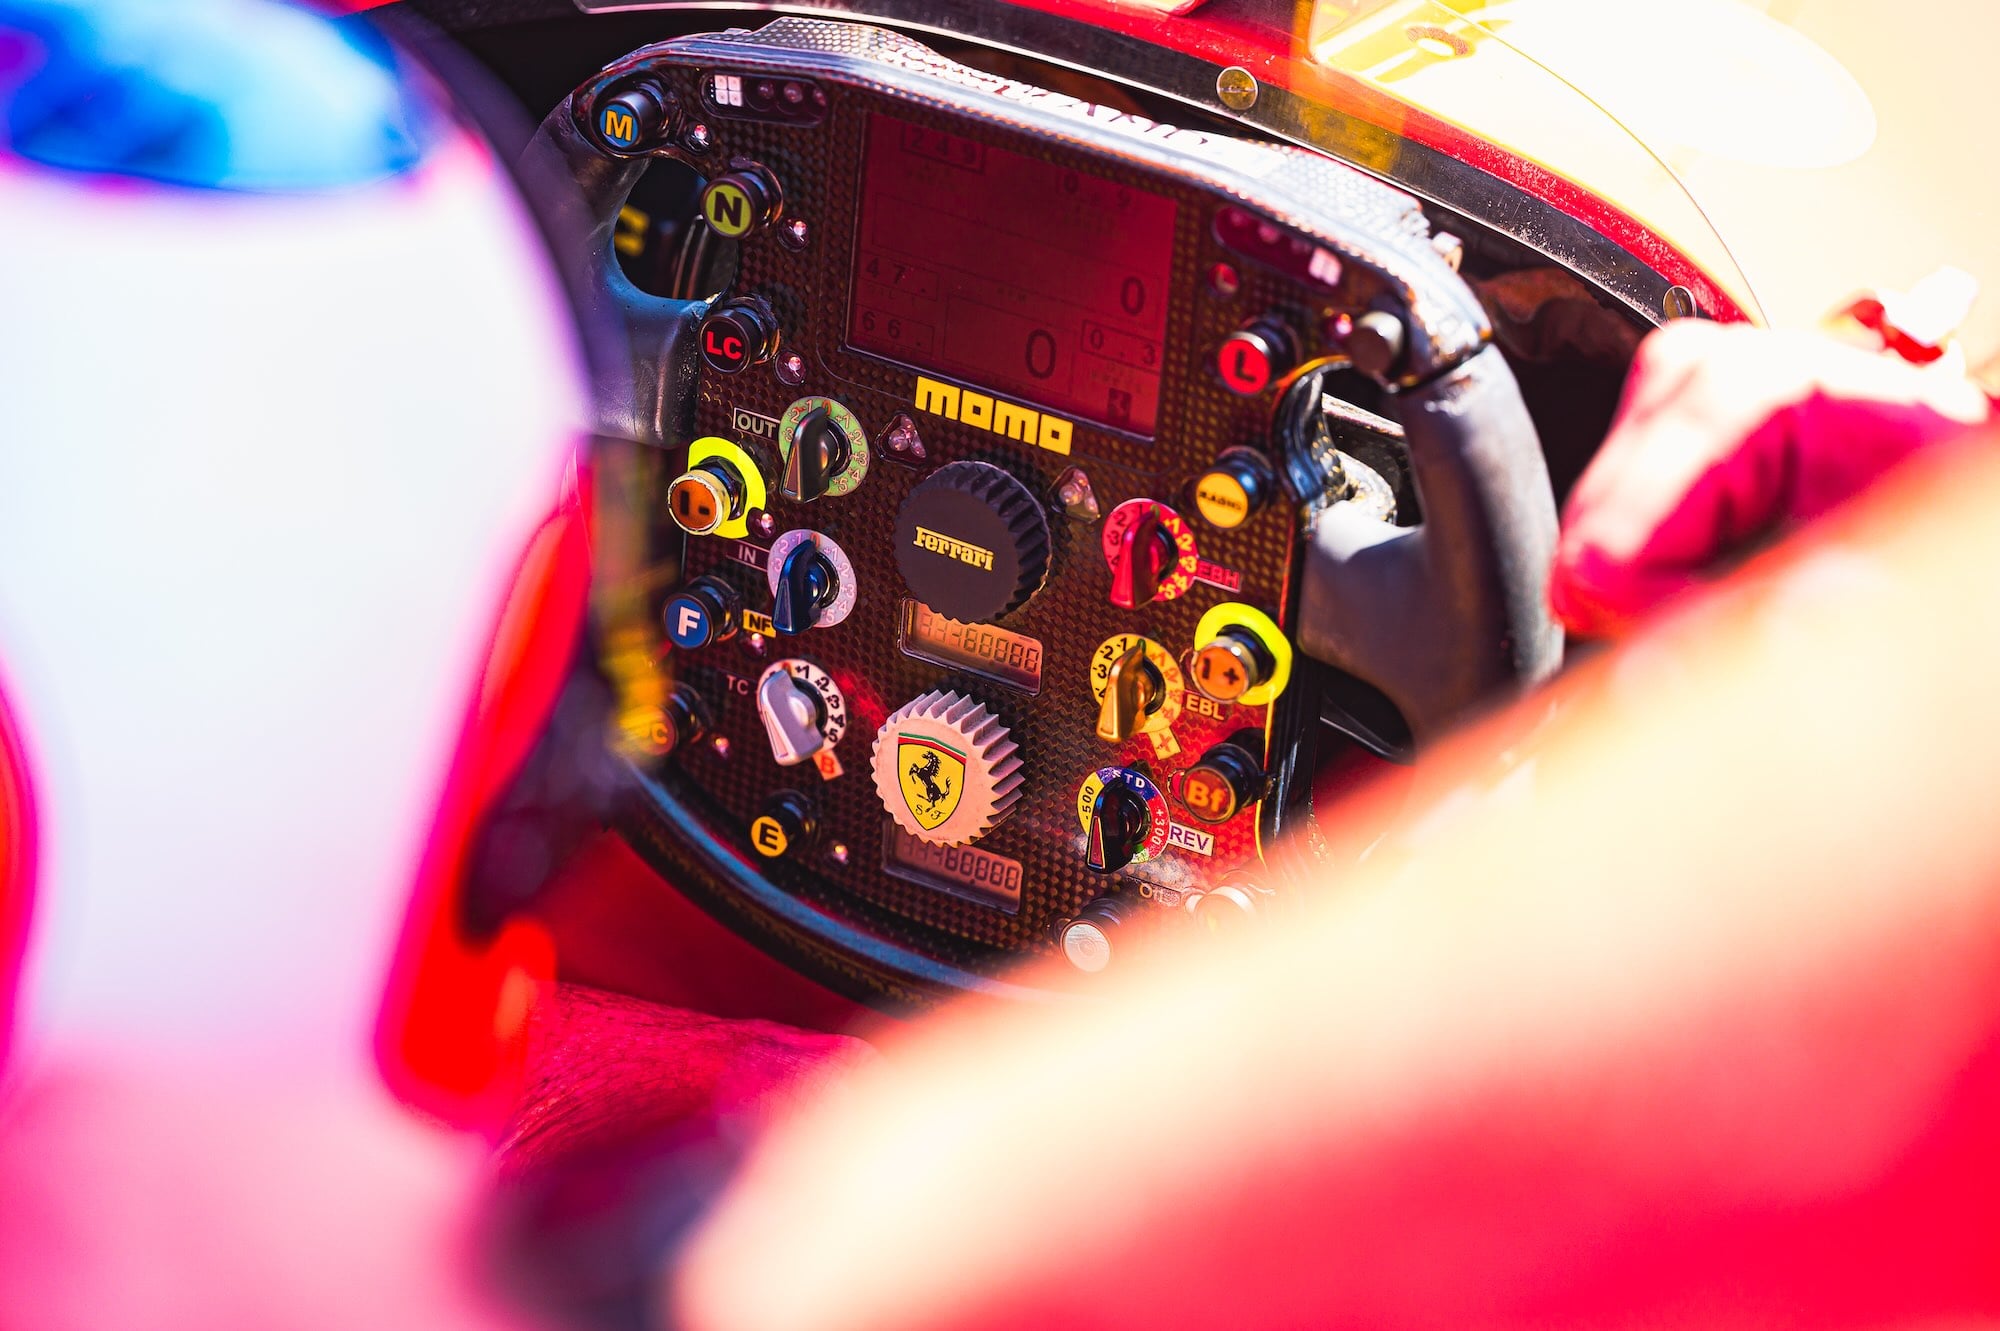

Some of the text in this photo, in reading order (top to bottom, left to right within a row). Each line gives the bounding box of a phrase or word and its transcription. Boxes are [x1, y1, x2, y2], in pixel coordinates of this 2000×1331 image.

[605, 109, 634, 142] M
[713, 191, 743, 228] N
[706, 330, 743, 361] LC
[1234, 350, 1257, 384] L
[736, 412, 778, 438] OUT
[737, 544, 757, 564] IN
[912, 525, 995, 572] Ferrari
[1198, 561, 1240, 590] EBH
[677, 605, 701, 637] F
[749, 614, 774, 634] NF
[1099, 645, 1114, 661] -2
[726, 674, 750, 696] TC
[1185, 693, 1225, 721] EBL
[1187, 779, 1226, 813] Bf
[758, 821, 779, 851] E
[1169, 825, 1210, 851] REV
